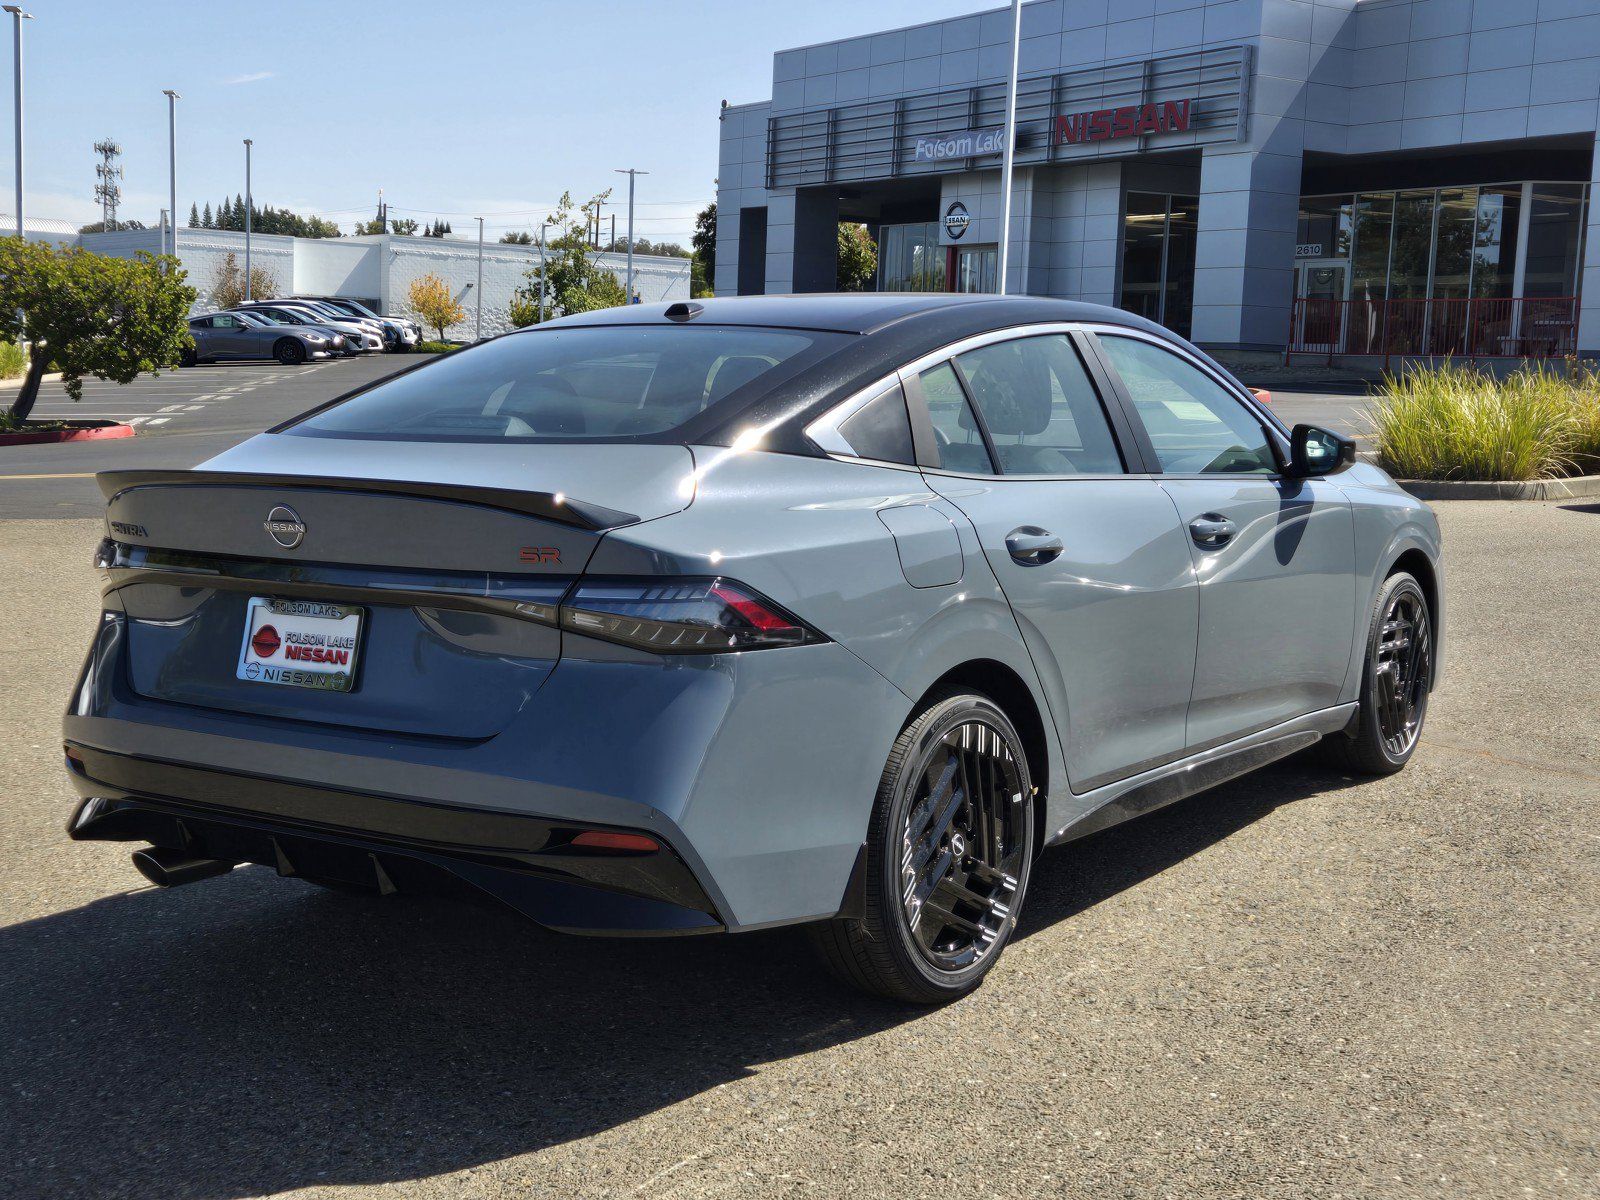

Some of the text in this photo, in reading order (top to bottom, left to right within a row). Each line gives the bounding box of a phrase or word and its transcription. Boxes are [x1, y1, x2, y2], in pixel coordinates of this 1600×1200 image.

[1055, 98, 1190, 145] NISSAN
[915, 129, 1004, 159] Folsom Lak
[1296, 245, 1321, 255] 2610
[263, 521, 305, 532] NISSAN
[519, 546, 562, 564] SR
[274, 601, 338, 617] FOLSOM LAKE
[285, 631, 355, 650] FOLSOM LAKE
[284, 645, 349, 665] NISSAN
[263, 668, 327, 686] NISSAN
